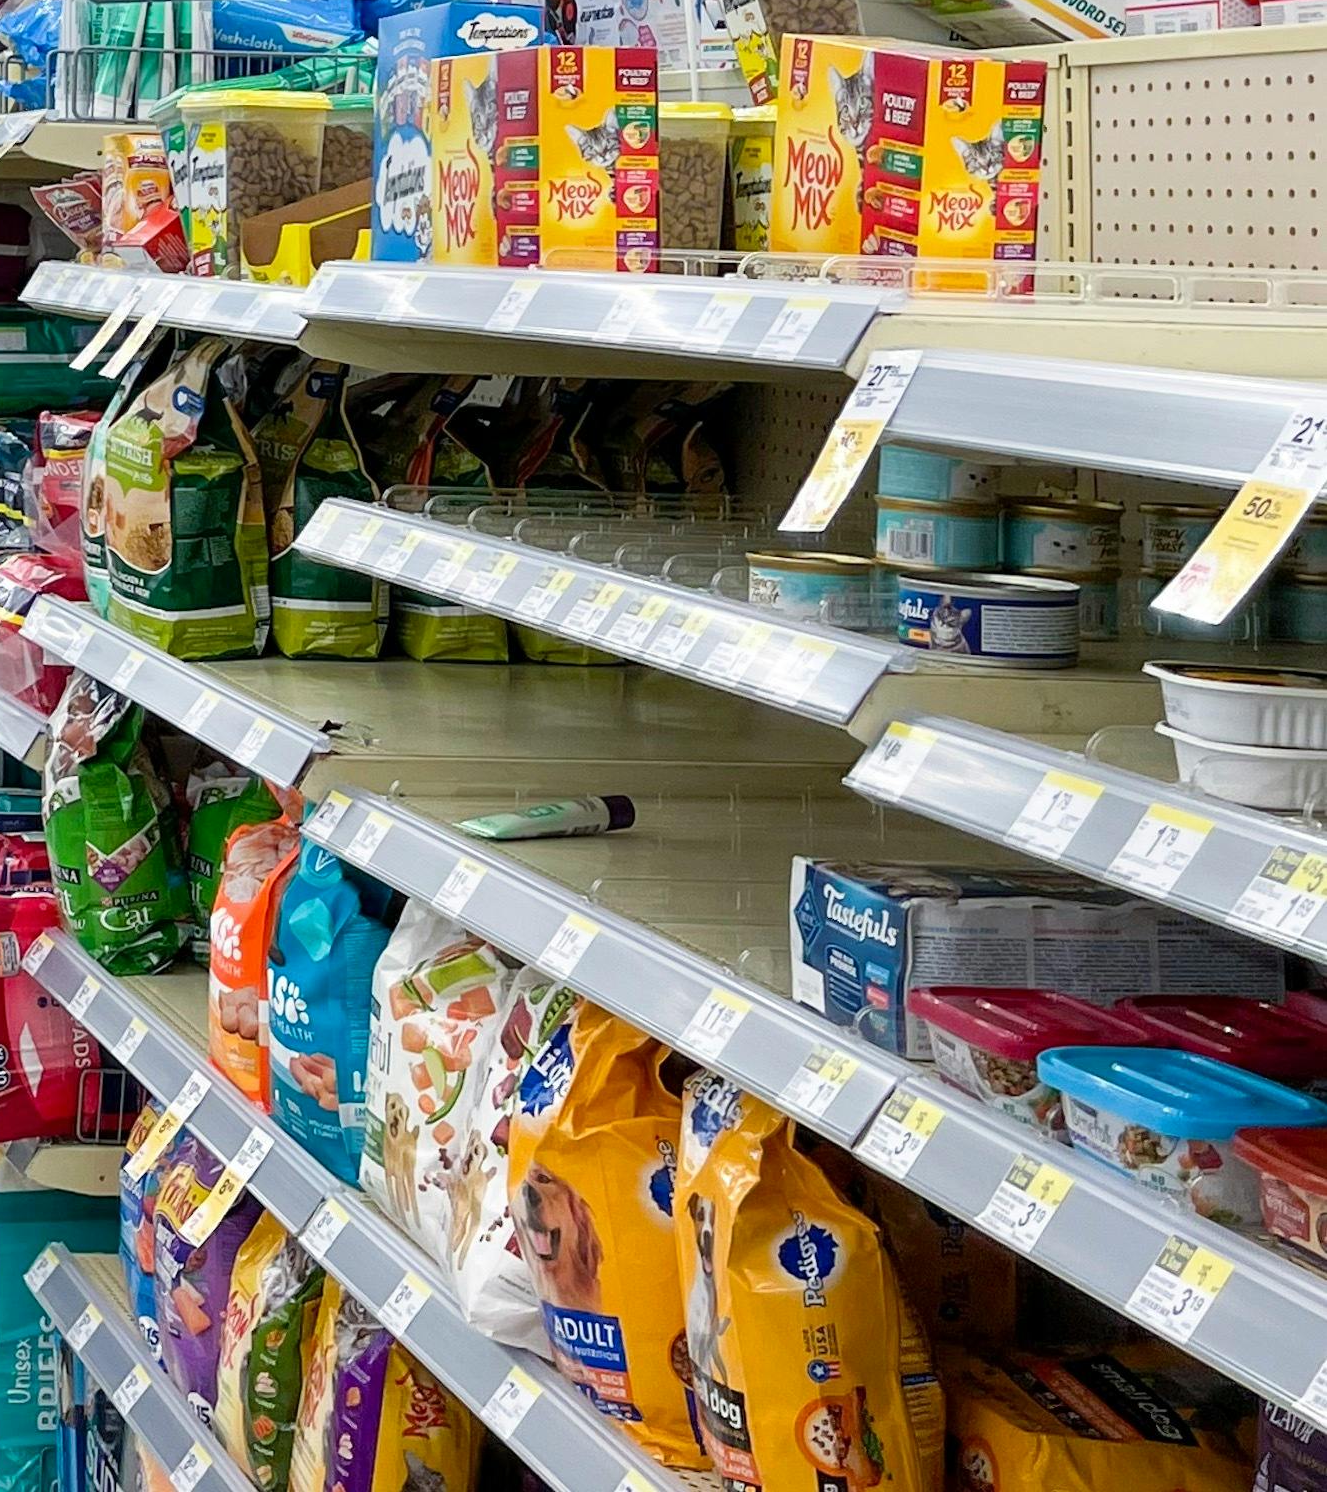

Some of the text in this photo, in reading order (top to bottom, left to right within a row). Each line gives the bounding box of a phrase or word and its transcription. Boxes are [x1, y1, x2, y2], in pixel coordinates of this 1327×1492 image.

[469, 20, 533, 42] Temptations
[556, 51, 577, 66] 12
[556, 64, 578, 74] CUP
[947, 63, 967, 79] 12
[946, 77, 968, 87] CUP
[881, 92, 916, 110] POULTRY
[1243, 496, 1272, 518] 50
[100, 906, 154, 934] Cat
[823, 882, 899, 947] Tastefuls
[804, 1210, 825, 1308] Pedigree
[552, 1314, 615, 1349] ADULT
[818, 1324, 827, 1356] USA
[7, 1337, 32, 1405] Unisex
[710, 1392, 742, 1429] dog
[1264, 1400, 1317, 1445] FLAVOR
